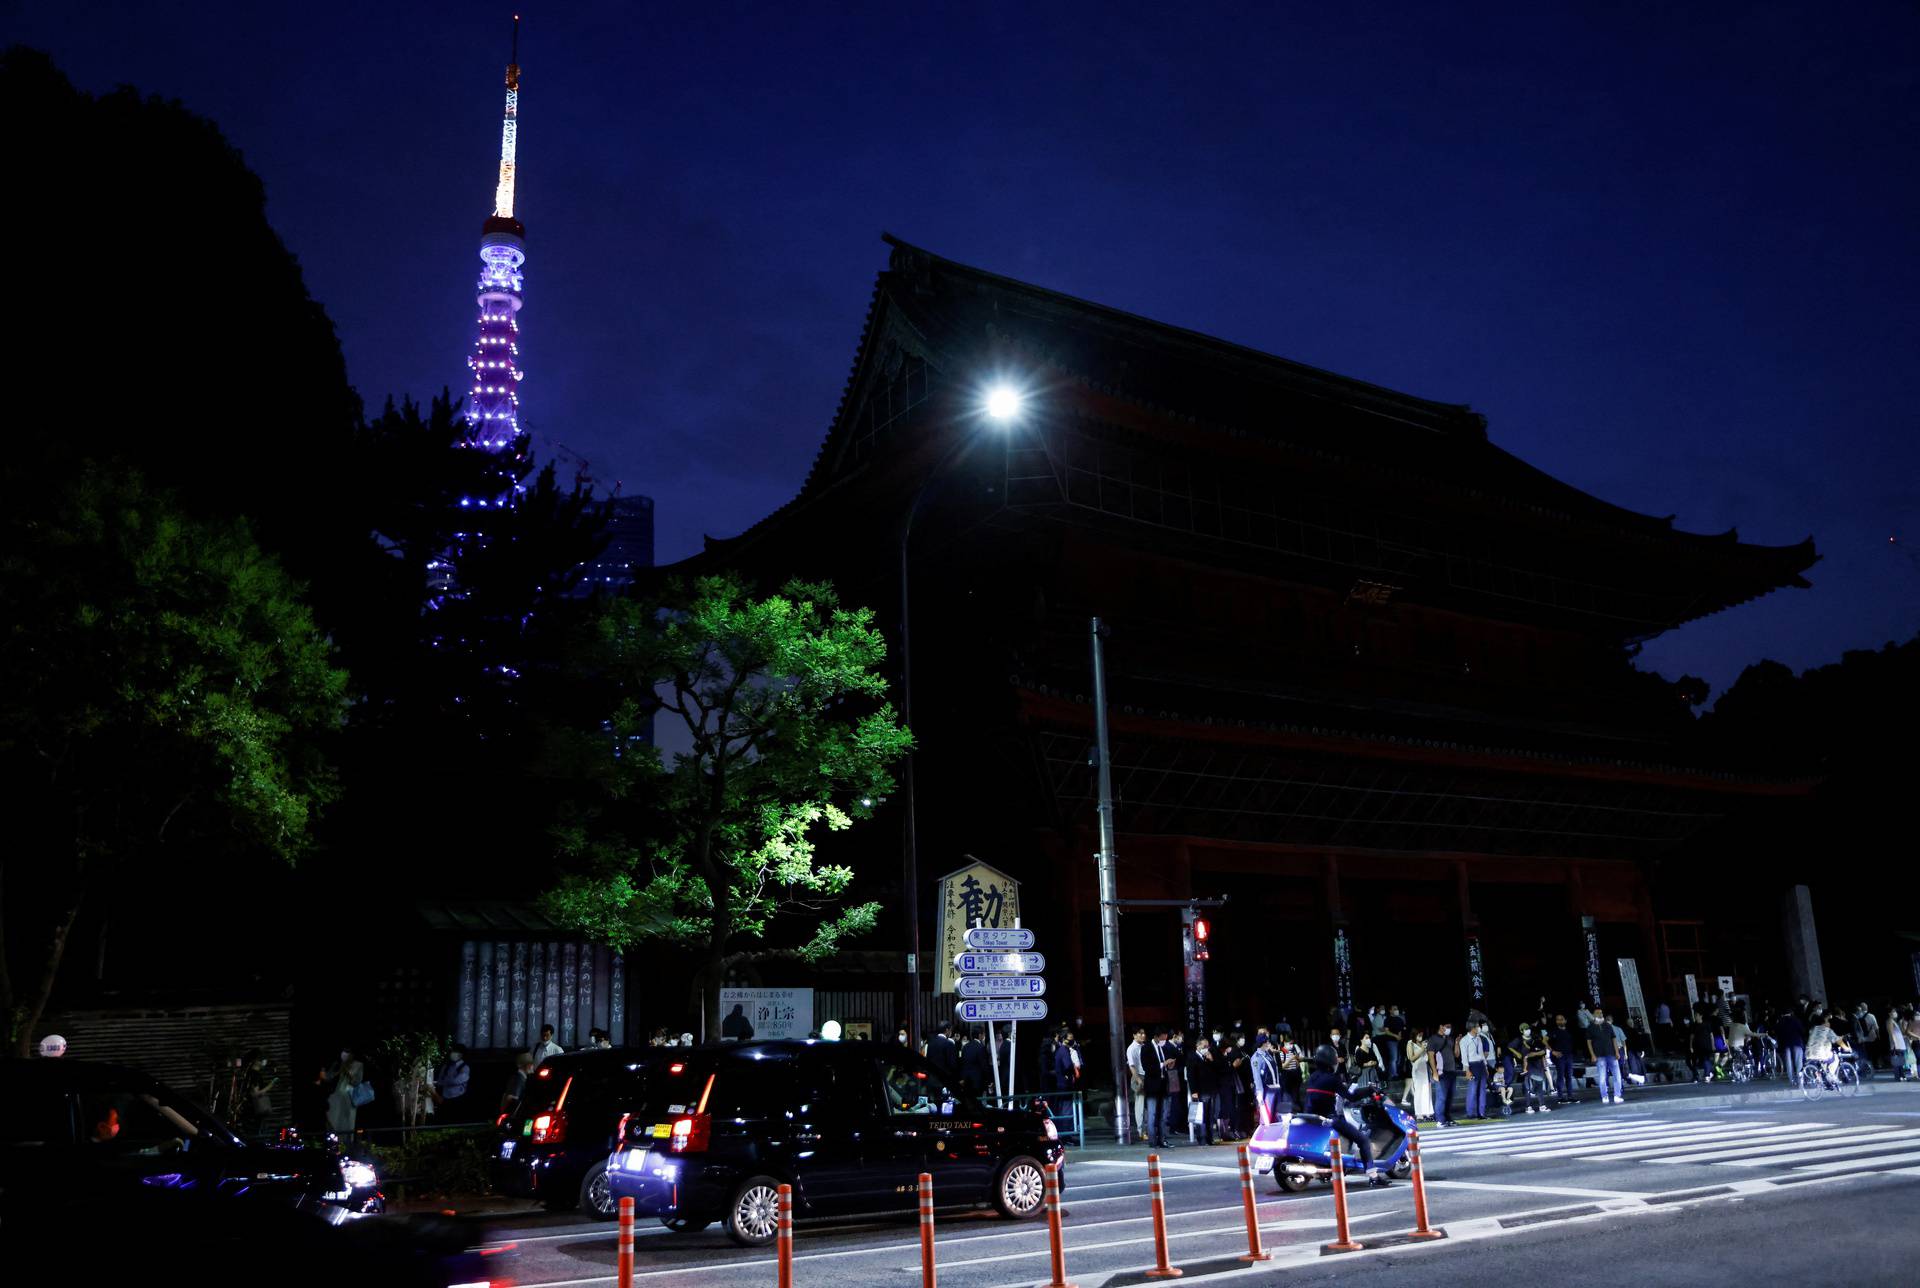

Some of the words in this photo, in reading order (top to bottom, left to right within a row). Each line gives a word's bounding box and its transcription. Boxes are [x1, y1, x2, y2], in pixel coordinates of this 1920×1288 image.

[974, 932, 1016, 940] 東京タワー
[978, 979, 1028, 987] 地下鉄芝公園駅
[979, 1002, 1029, 1011] 地下鉄大門駅
[758, 1006, 795, 1020] 浄土宗
[928, 1121, 953, 1129] TEITO
[954, 1121, 971, 1129] TAXI
